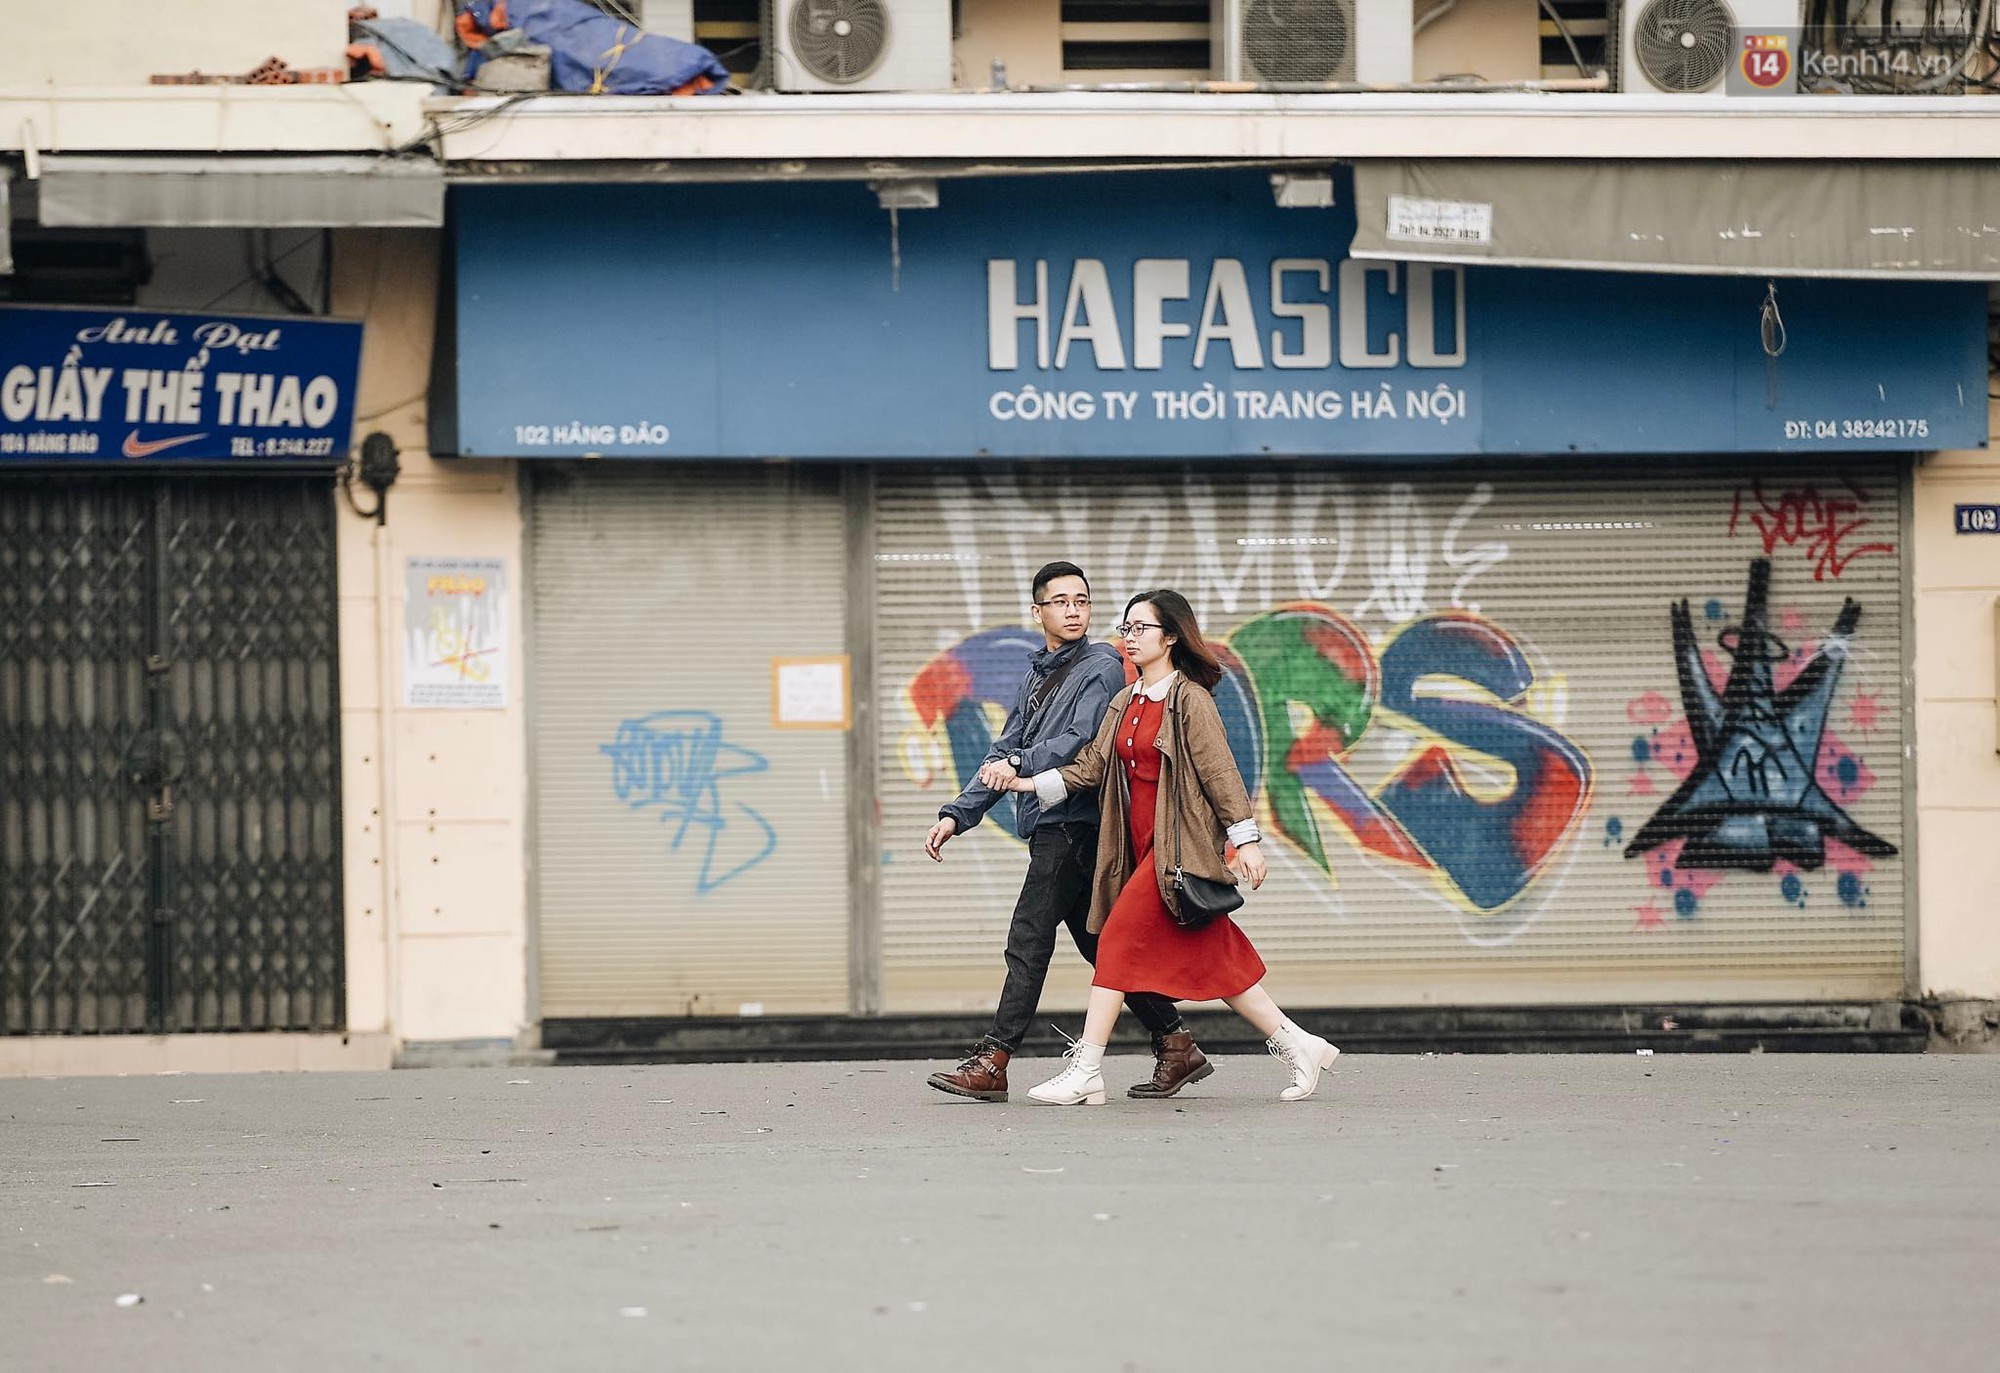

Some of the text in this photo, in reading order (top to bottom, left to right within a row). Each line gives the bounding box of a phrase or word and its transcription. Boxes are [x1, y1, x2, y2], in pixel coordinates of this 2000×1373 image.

[988, 258, 1466, 369] HAFASCO
[76, 317, 281, 354] Anh Đạt
[122, 348, 210, 424] THỂ
[216, 372, 338, 430] THAO
[989, 382, 1465, 424] CÔNG TY THỜI TRANG HÀ NỘI
[515, 425, 549, 445] 102
[1785, 419, 1928, 439] ĐT: 04 38242175
[1961, 509, 1997, 530] 102
